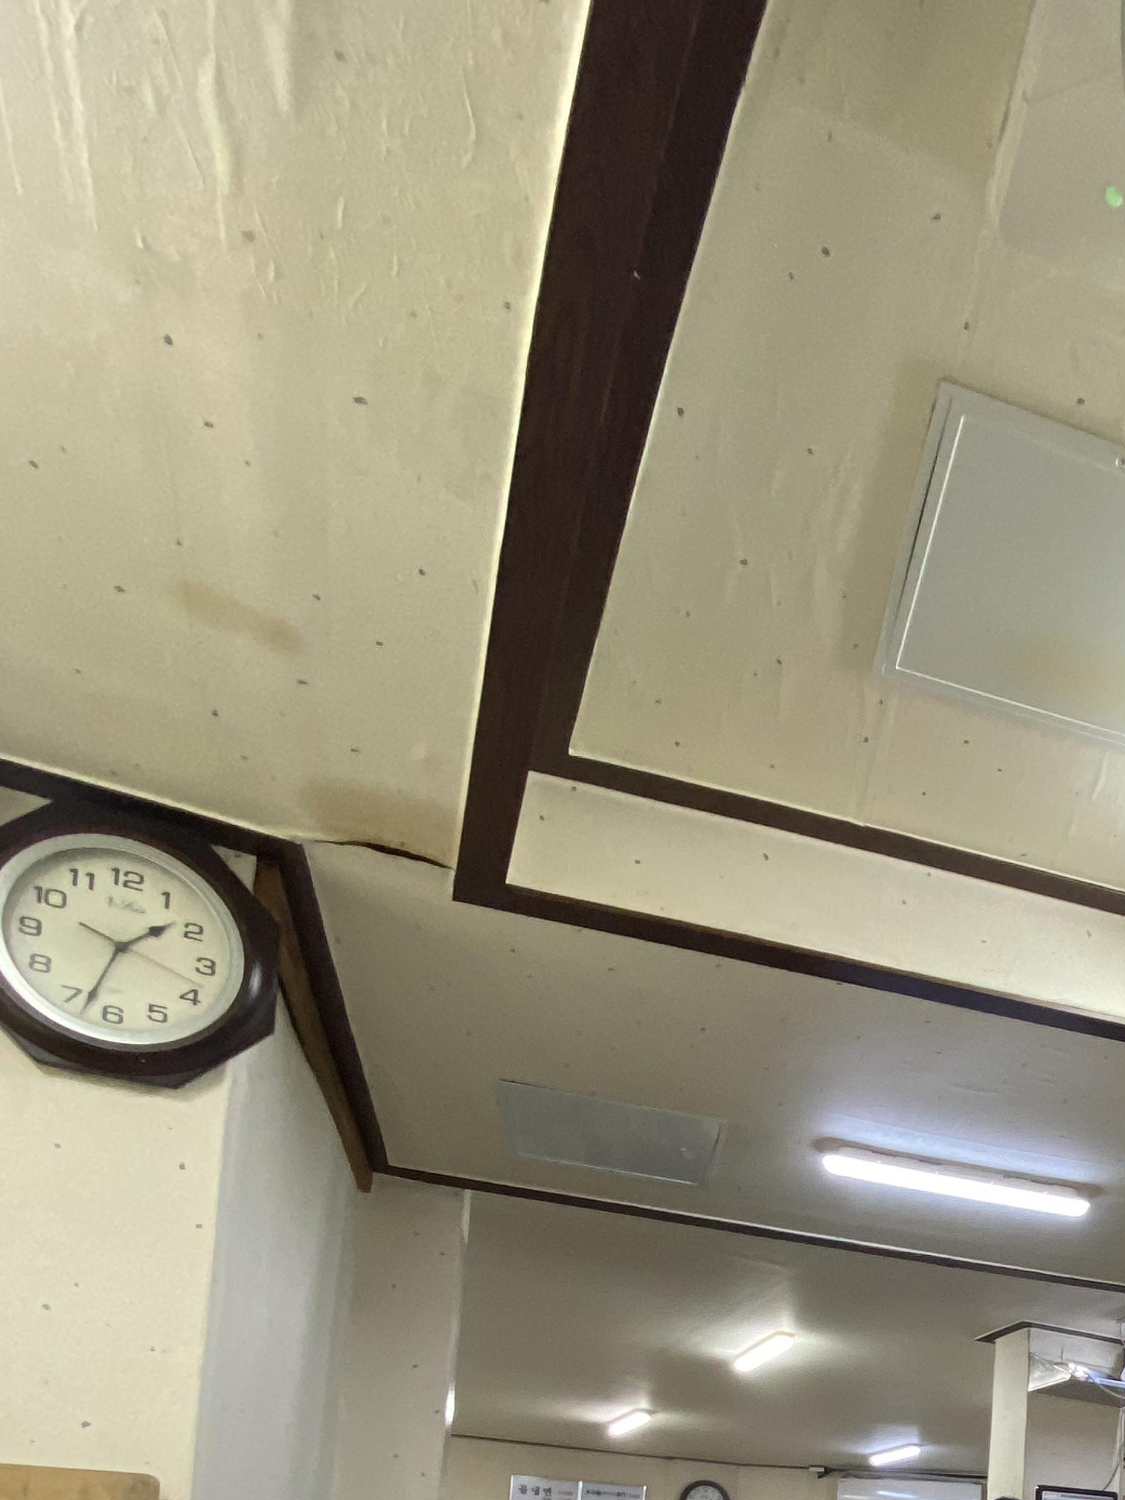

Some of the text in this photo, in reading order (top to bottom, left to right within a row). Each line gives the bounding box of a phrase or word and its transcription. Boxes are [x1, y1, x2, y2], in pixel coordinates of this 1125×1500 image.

[69, 868, 95, 891] 11
[111, 867, 145, 892] 12
[33, 885, 68, 909] 10
[161, 891, 171, 910] 1
[18, 915, 43, 937] 9
[183, 922, 204, 942] 2
[28, 954, 52, 974] 8
[195, 957, 217, 977] 3
[61, 985, 83, 1004] 7
[179, 989, 202, 1007] 4
[102, 1005, 124, 1025] 6
[147, 1003, 169, 1024] 5
